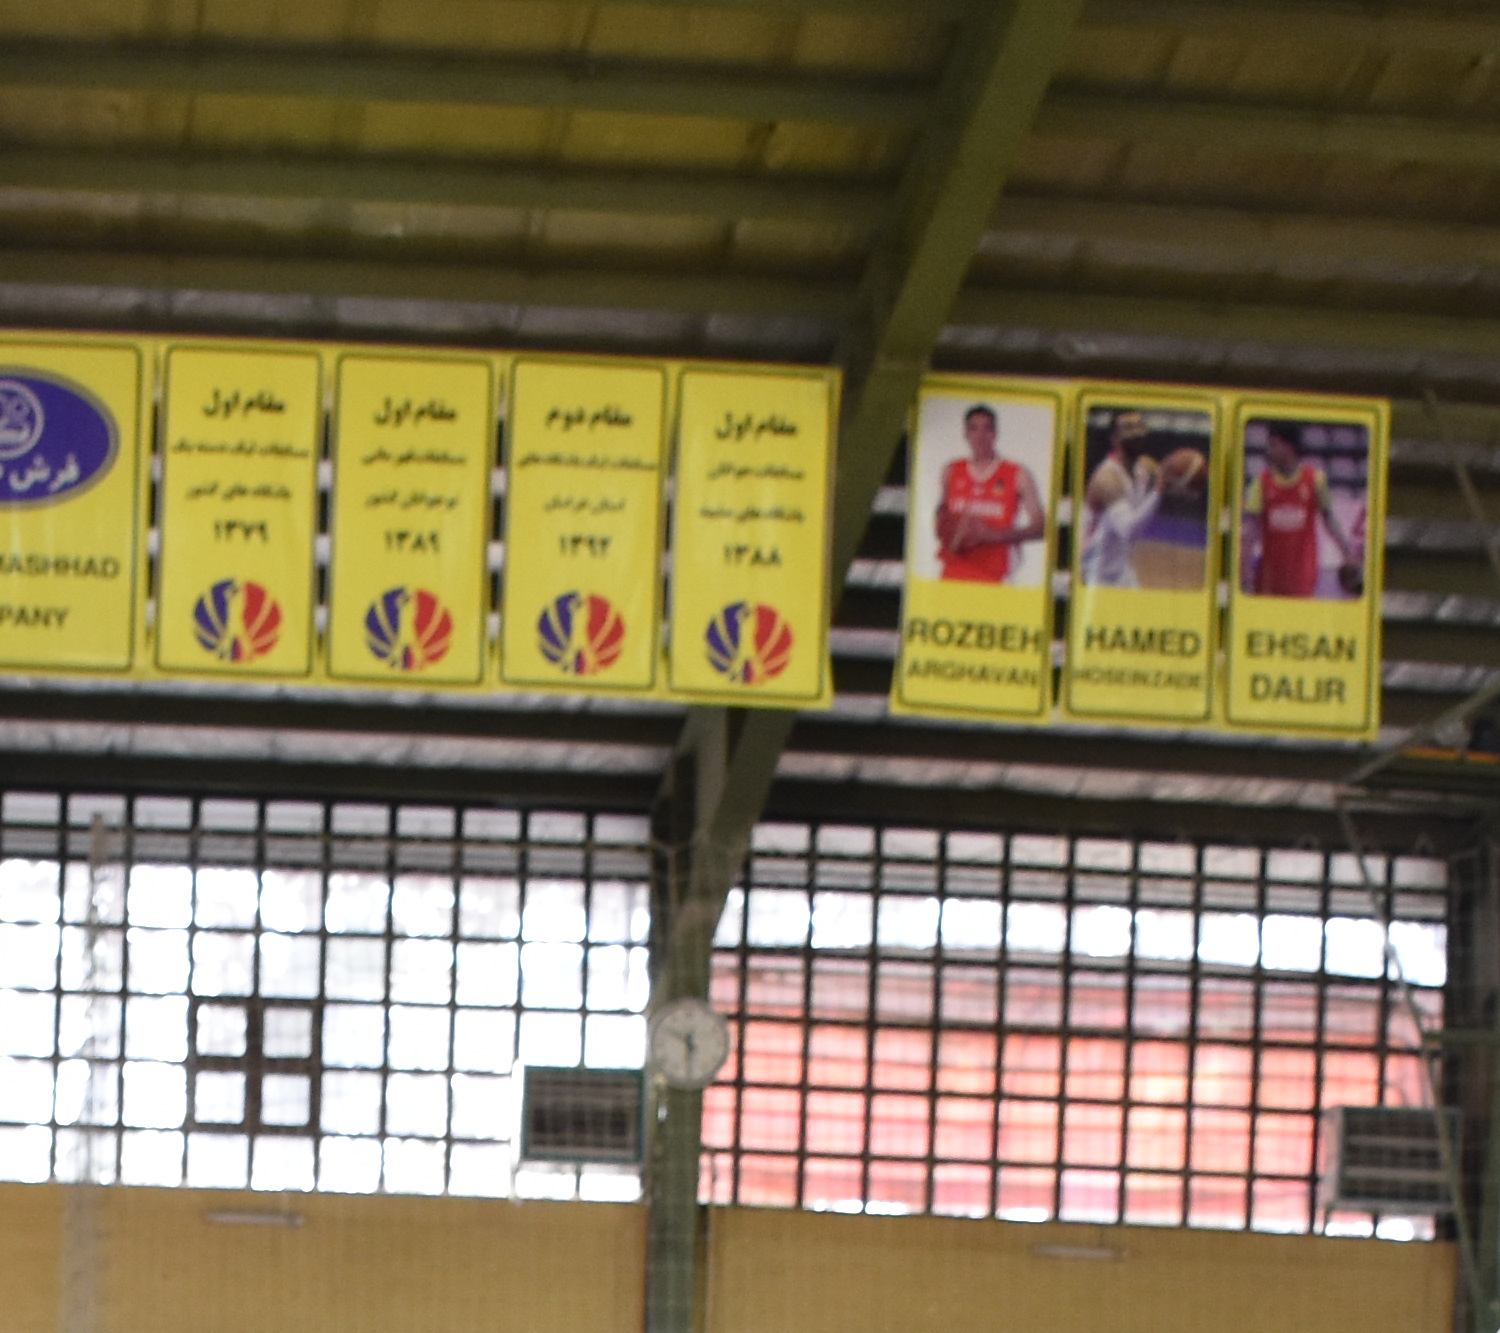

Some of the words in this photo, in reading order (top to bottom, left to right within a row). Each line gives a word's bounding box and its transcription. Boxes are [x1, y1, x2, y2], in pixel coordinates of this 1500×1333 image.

[202, 387, 240, 420] اول
[374, 396, 413, 429] اول
[714, 412, 753, 444] اول
[9, 452, 80, 494] فرش
[907, 617, 1041, 653] ROZBEH
[1084, 625, 1202, 658] HAMED
[1246, 630, 1358, 662] EHSAN
[1250, 673, 1347, 705] DALIR
